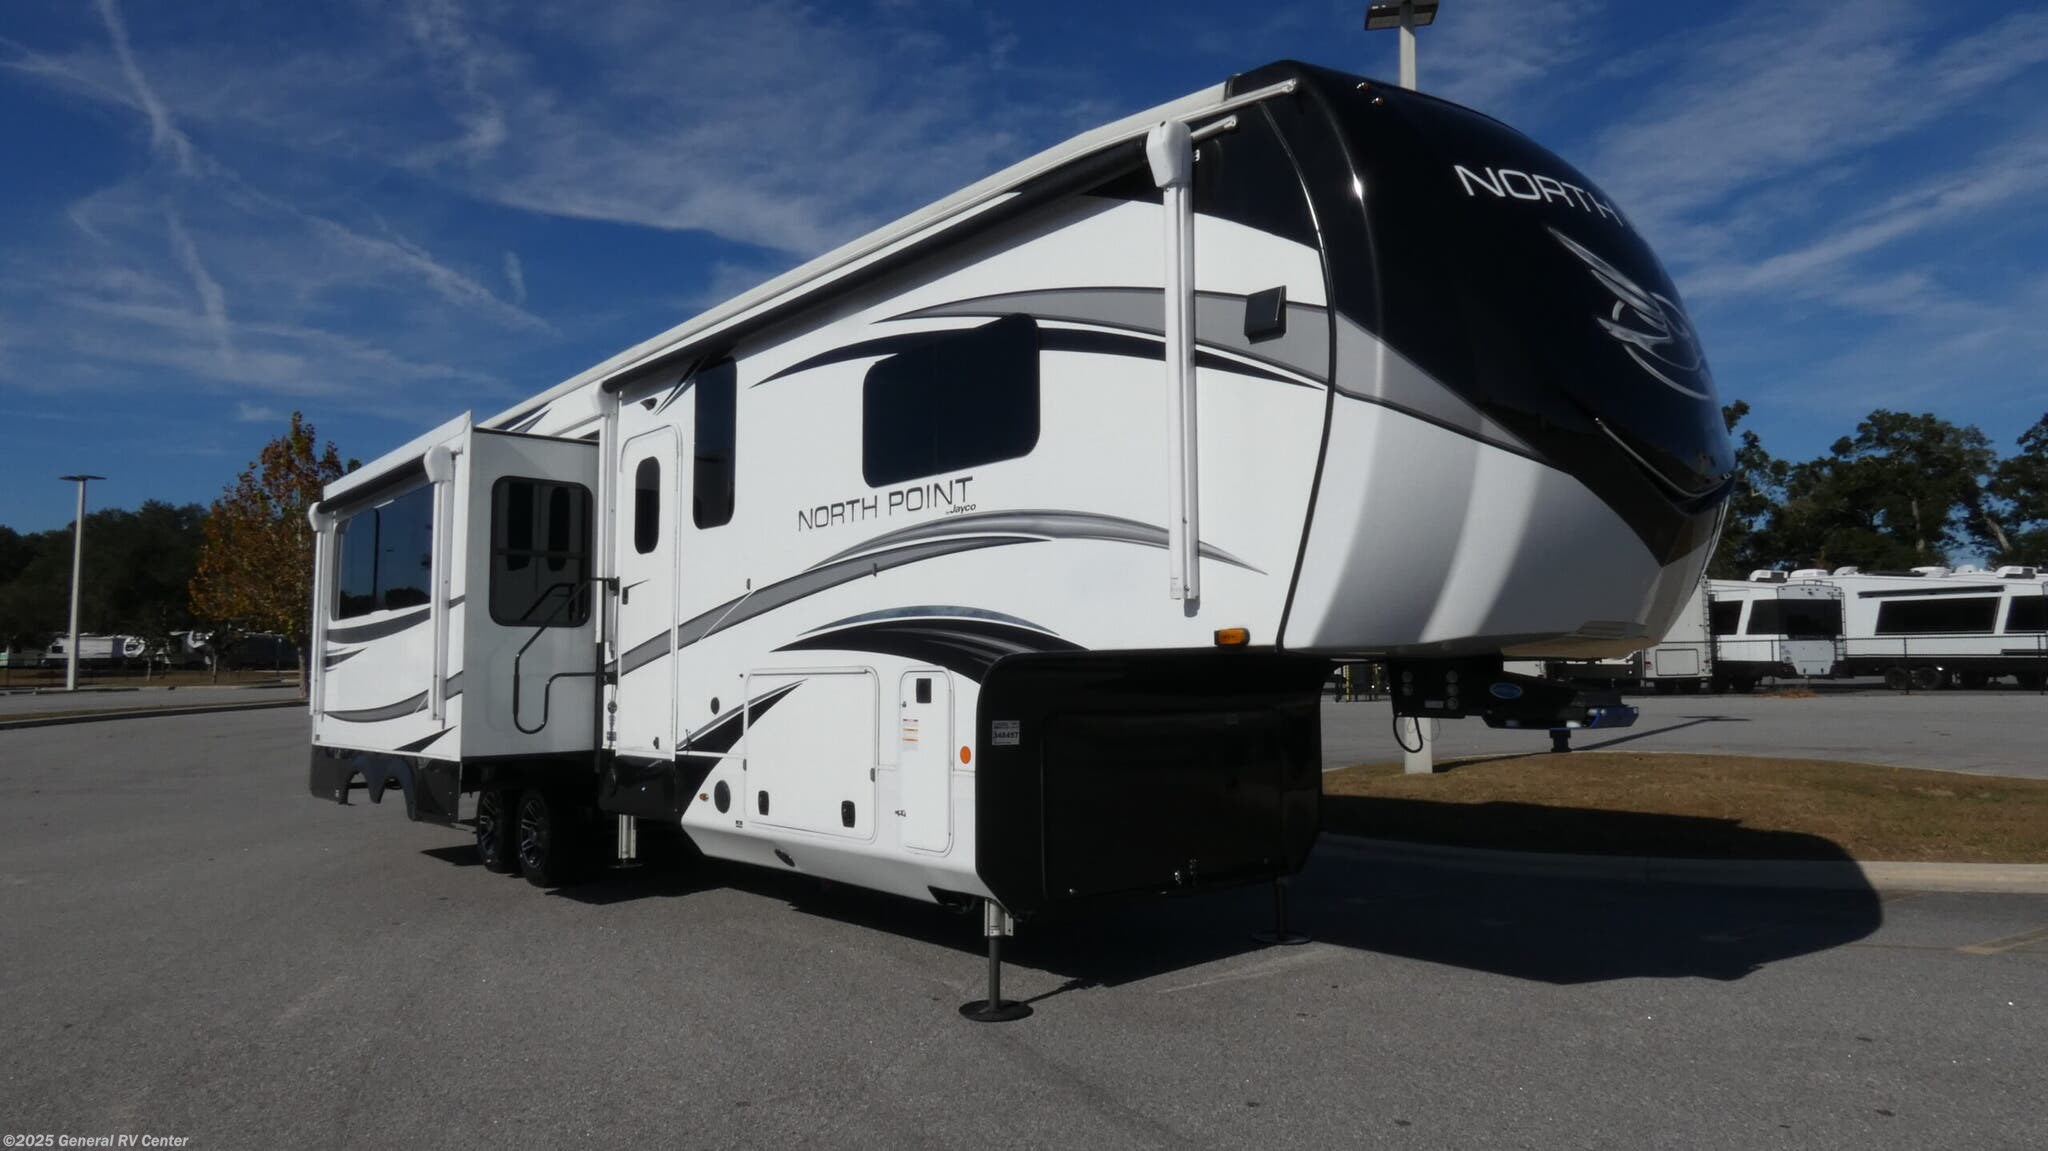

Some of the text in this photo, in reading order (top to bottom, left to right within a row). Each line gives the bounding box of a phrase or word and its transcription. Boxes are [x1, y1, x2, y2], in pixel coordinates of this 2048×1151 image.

[1453, 164, 1624, 227] NORTH
[798, 475, 974, 532] NORTH POINT
[949, 503, 977, 515] Jayco
